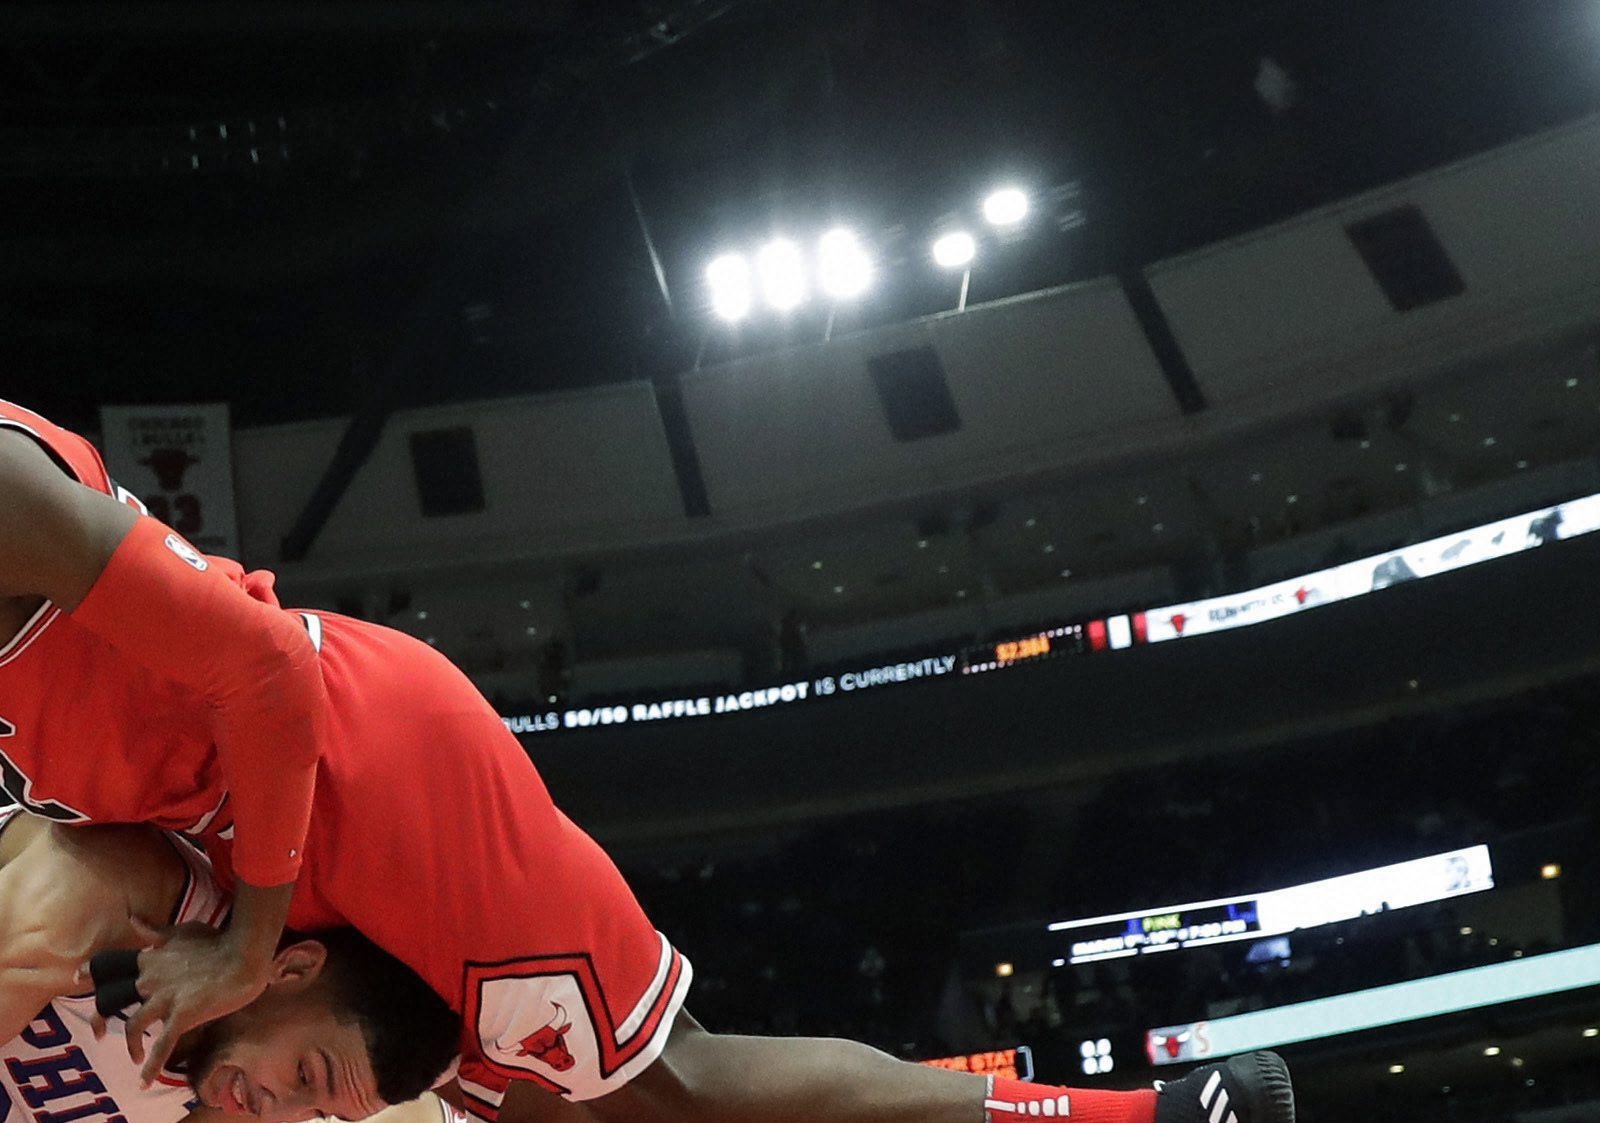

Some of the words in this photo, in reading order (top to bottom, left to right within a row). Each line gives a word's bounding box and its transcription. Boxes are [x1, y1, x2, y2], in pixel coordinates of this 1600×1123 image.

[564, 705, 628, 728] 50/50
[632, 697, 711, 722] RAFFLE
[715, 681, 809, 713] JACKPOT
[815, 676, 836, 696] IS
[840, 654, 957, 691] CURRENTLY
